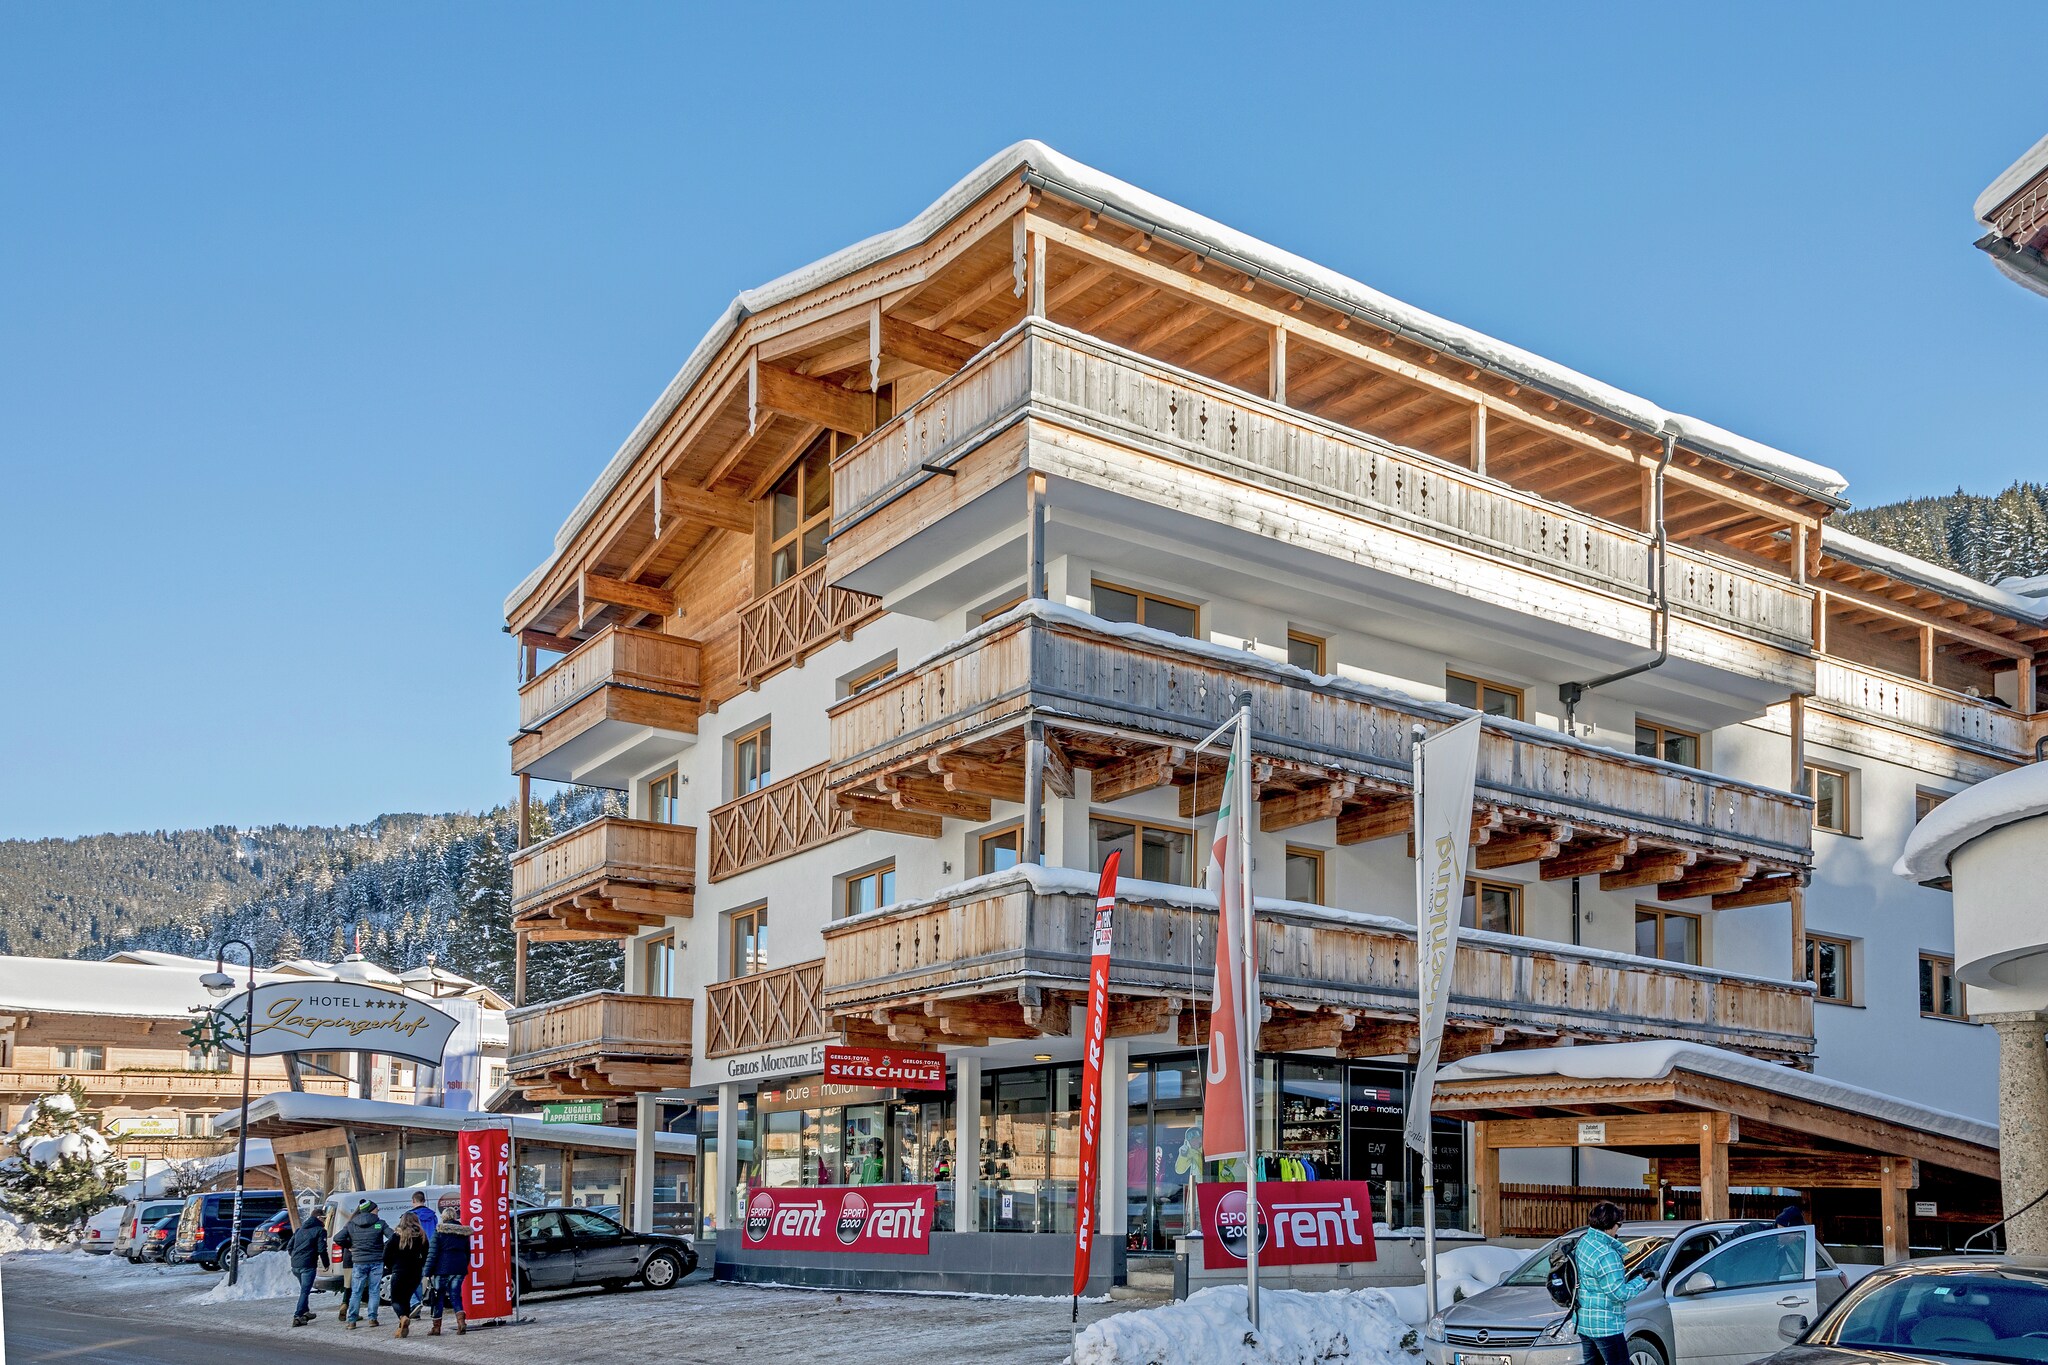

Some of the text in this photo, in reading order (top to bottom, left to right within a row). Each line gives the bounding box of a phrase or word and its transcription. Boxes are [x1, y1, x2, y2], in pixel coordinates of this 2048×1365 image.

[309, 996, 360, 1008] HOTEL
[229, 997, 430, 1039] Gaspingerhof
[1089, 969, 1105, 1072] Rent
[830, 1064, 940, 1080] SKISCHULE
[786, 1086, 809, 1103] pure
[563, 1106, 592, 1114] ZUGANG
[1350, 1104, 1369, 1114] pure
[1376, 1105, 1403, 1115] motion
[549, 1113, 601, 1122] APPARTEMENTS
[1368, 1142, 1387, 1154] EA7
[440, 1199, 461, 1207] SPOR
[750, 1208, 772, 1217] SPORT
[772, 1200, 827, 1237] rent
[842, 1208, 866, 1218] SPORT
[866, 1197, 926, 1239] rent
[1219, 1211, 1261, 1225] SPO
[467, 1144, 485, 1305] SKISCHULE
[749, 1218, 767, 1227] 2000
[840, 1219, 861, 1228] 2000
[1273, 1197, 1363, 1248] rent
[1225, 1225, 1260, 1239] 200
